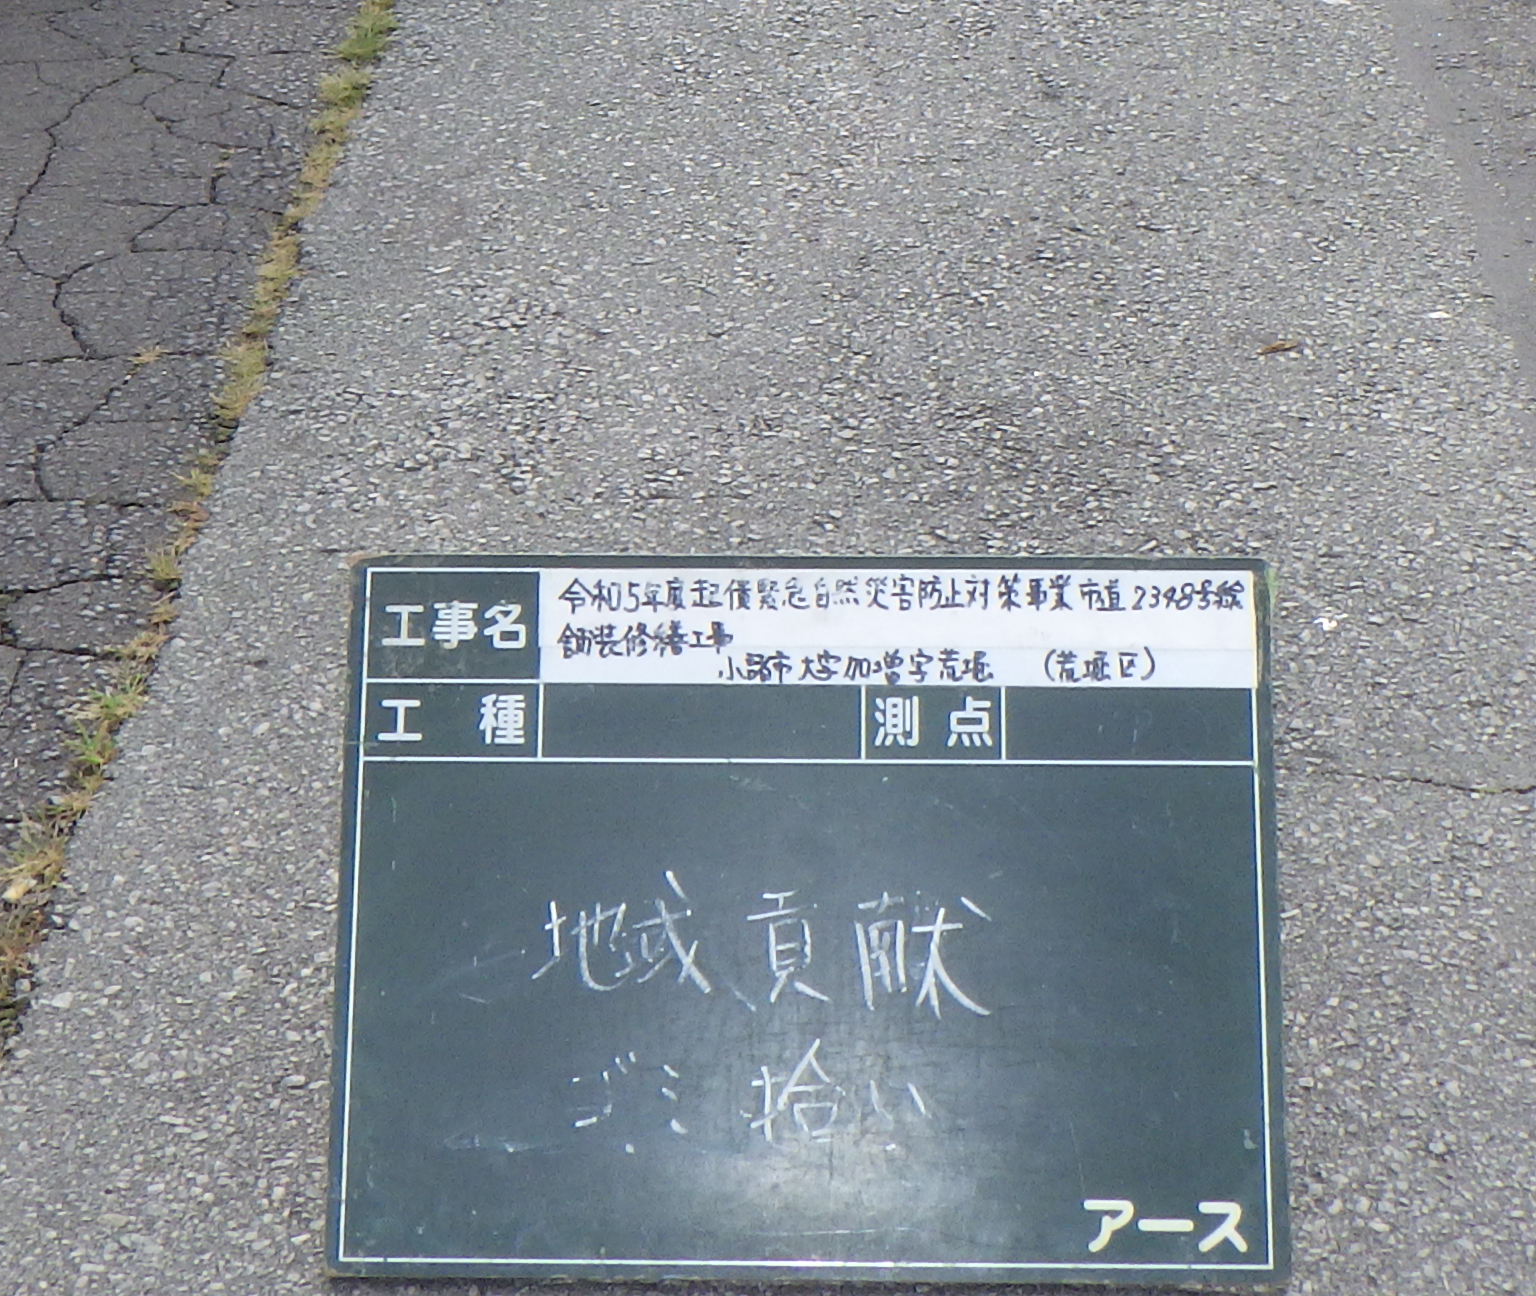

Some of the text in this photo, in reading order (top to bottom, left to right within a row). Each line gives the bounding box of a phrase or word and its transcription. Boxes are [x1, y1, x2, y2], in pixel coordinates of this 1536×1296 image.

[381, 600, 527, 650] 工事名
[1083, 1198, 1249, 1253] アース
